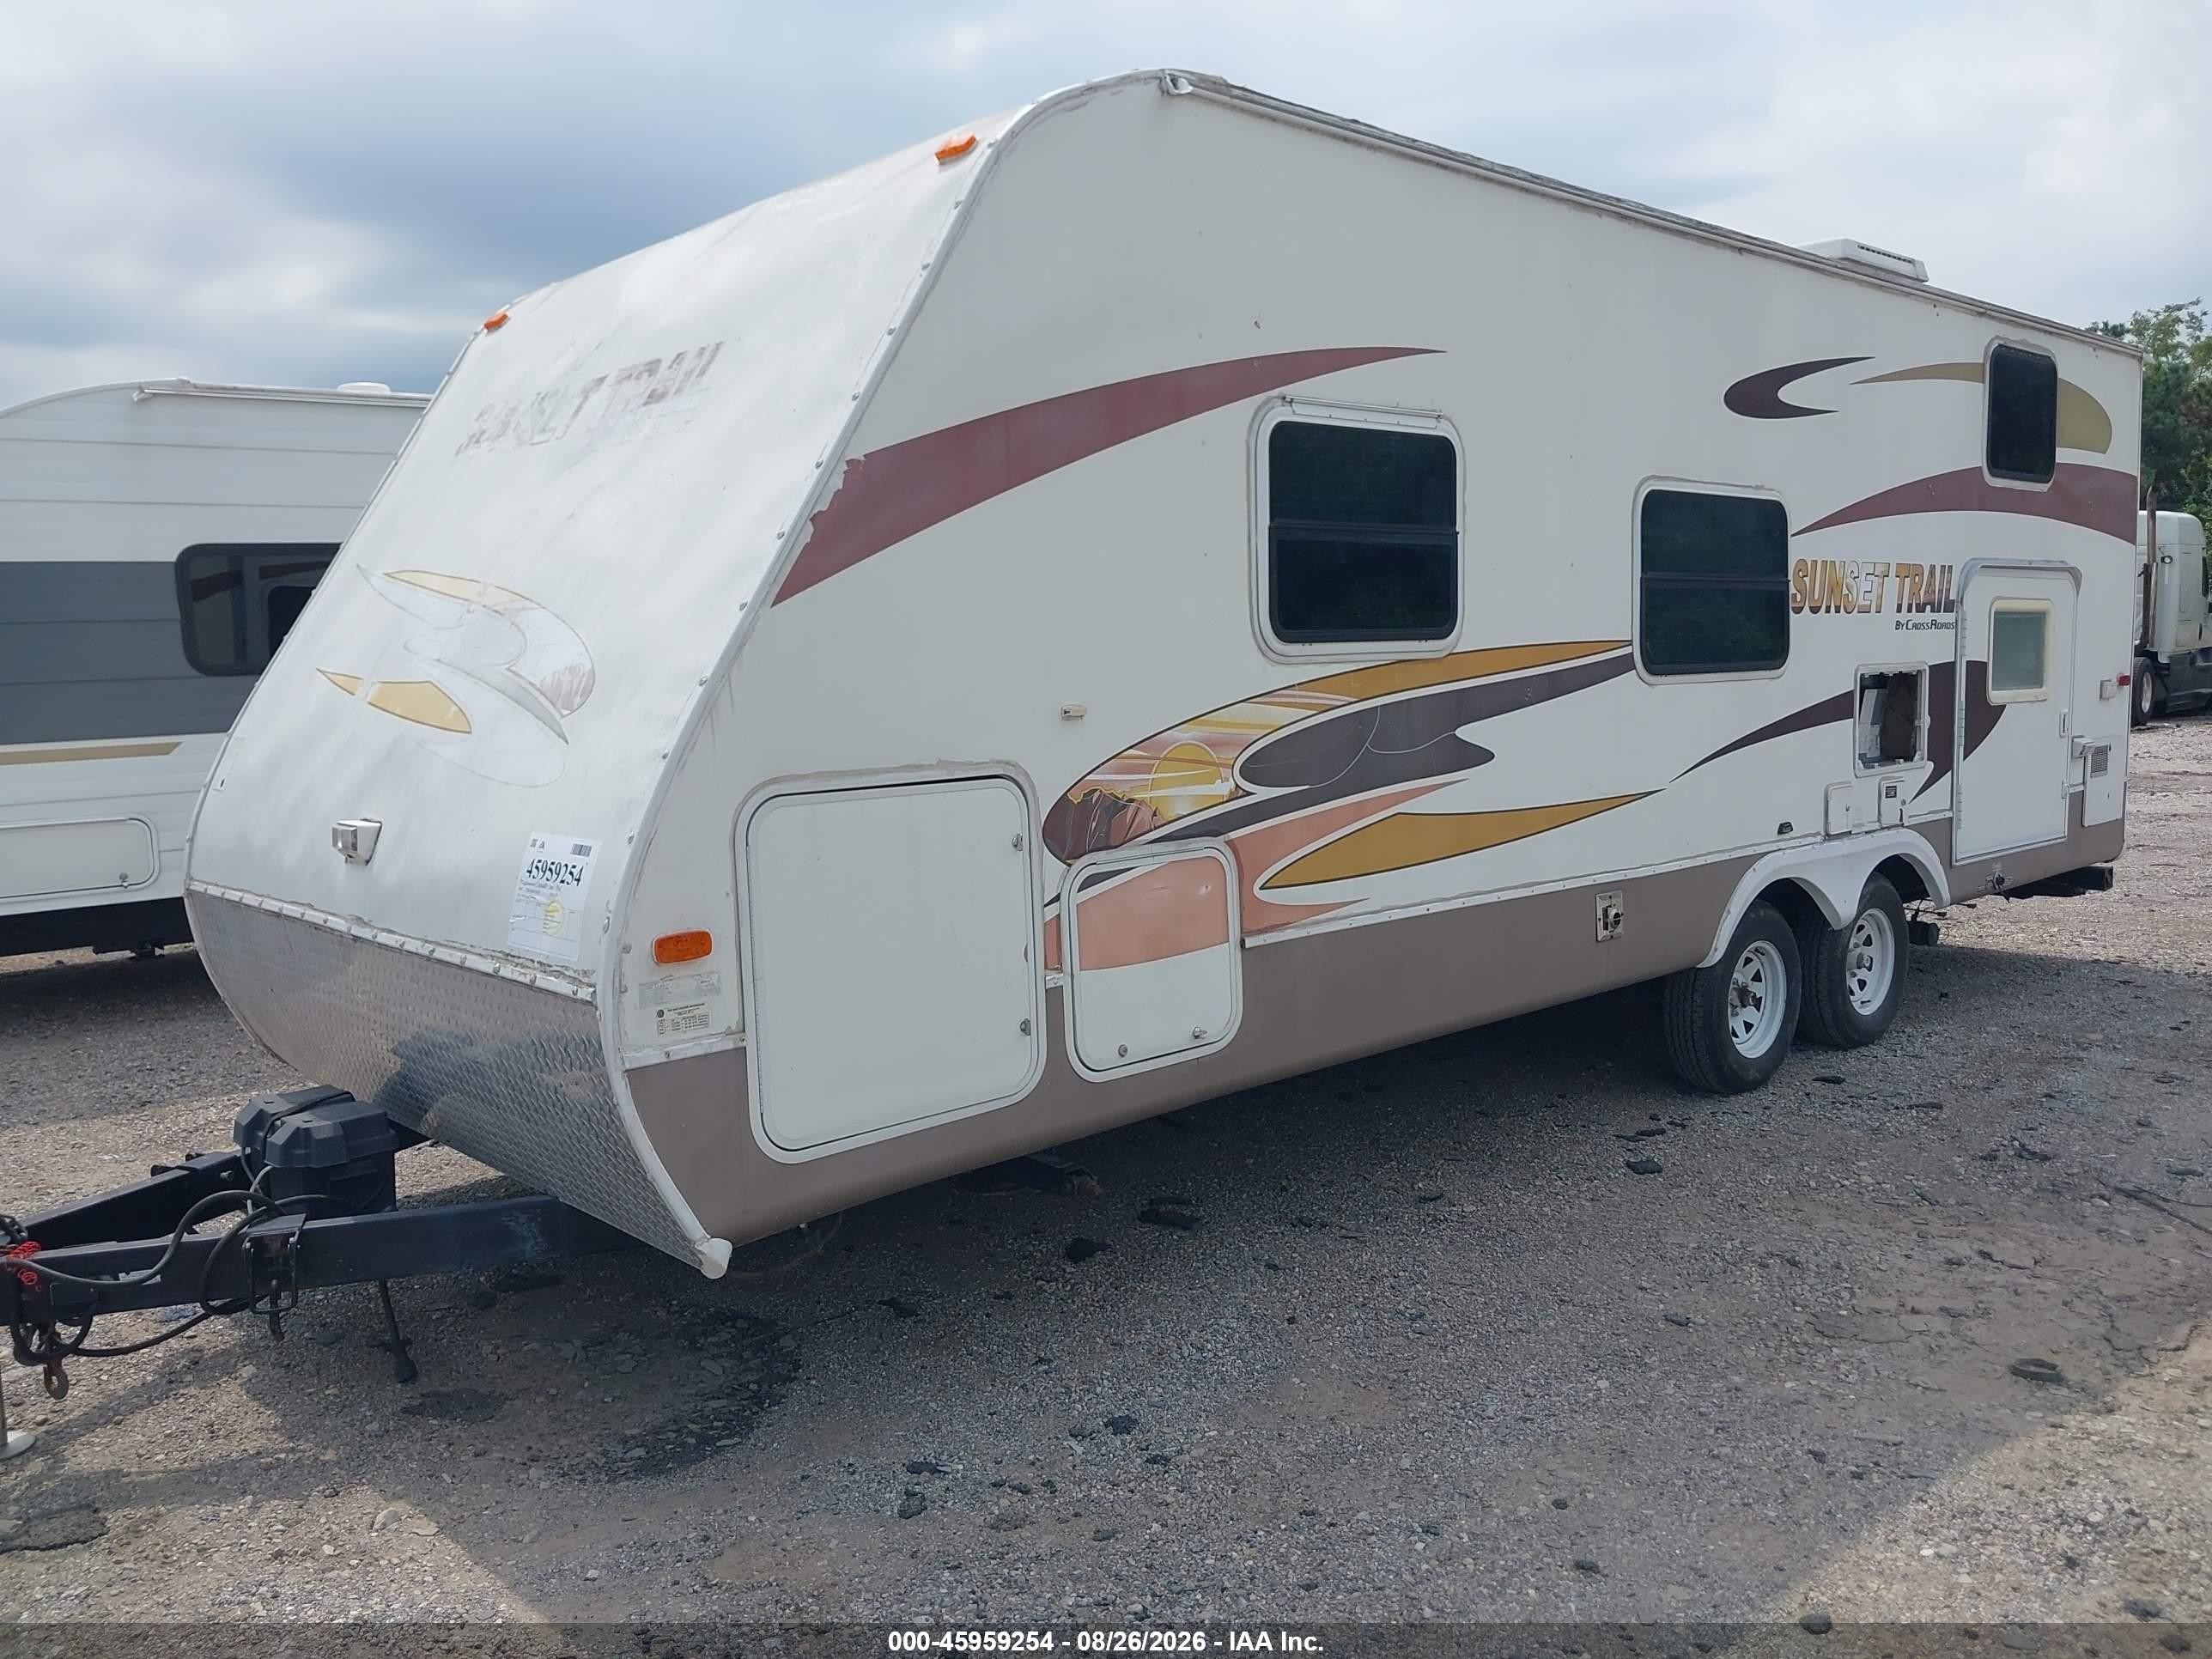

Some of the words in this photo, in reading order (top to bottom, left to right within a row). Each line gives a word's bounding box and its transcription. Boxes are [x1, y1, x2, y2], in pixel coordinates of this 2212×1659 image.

[1791, 558, 1891, 614] SUNSET
[1894, 562, 1955, 613] TRAIL
[526, 858, 584, 887] 45959254
